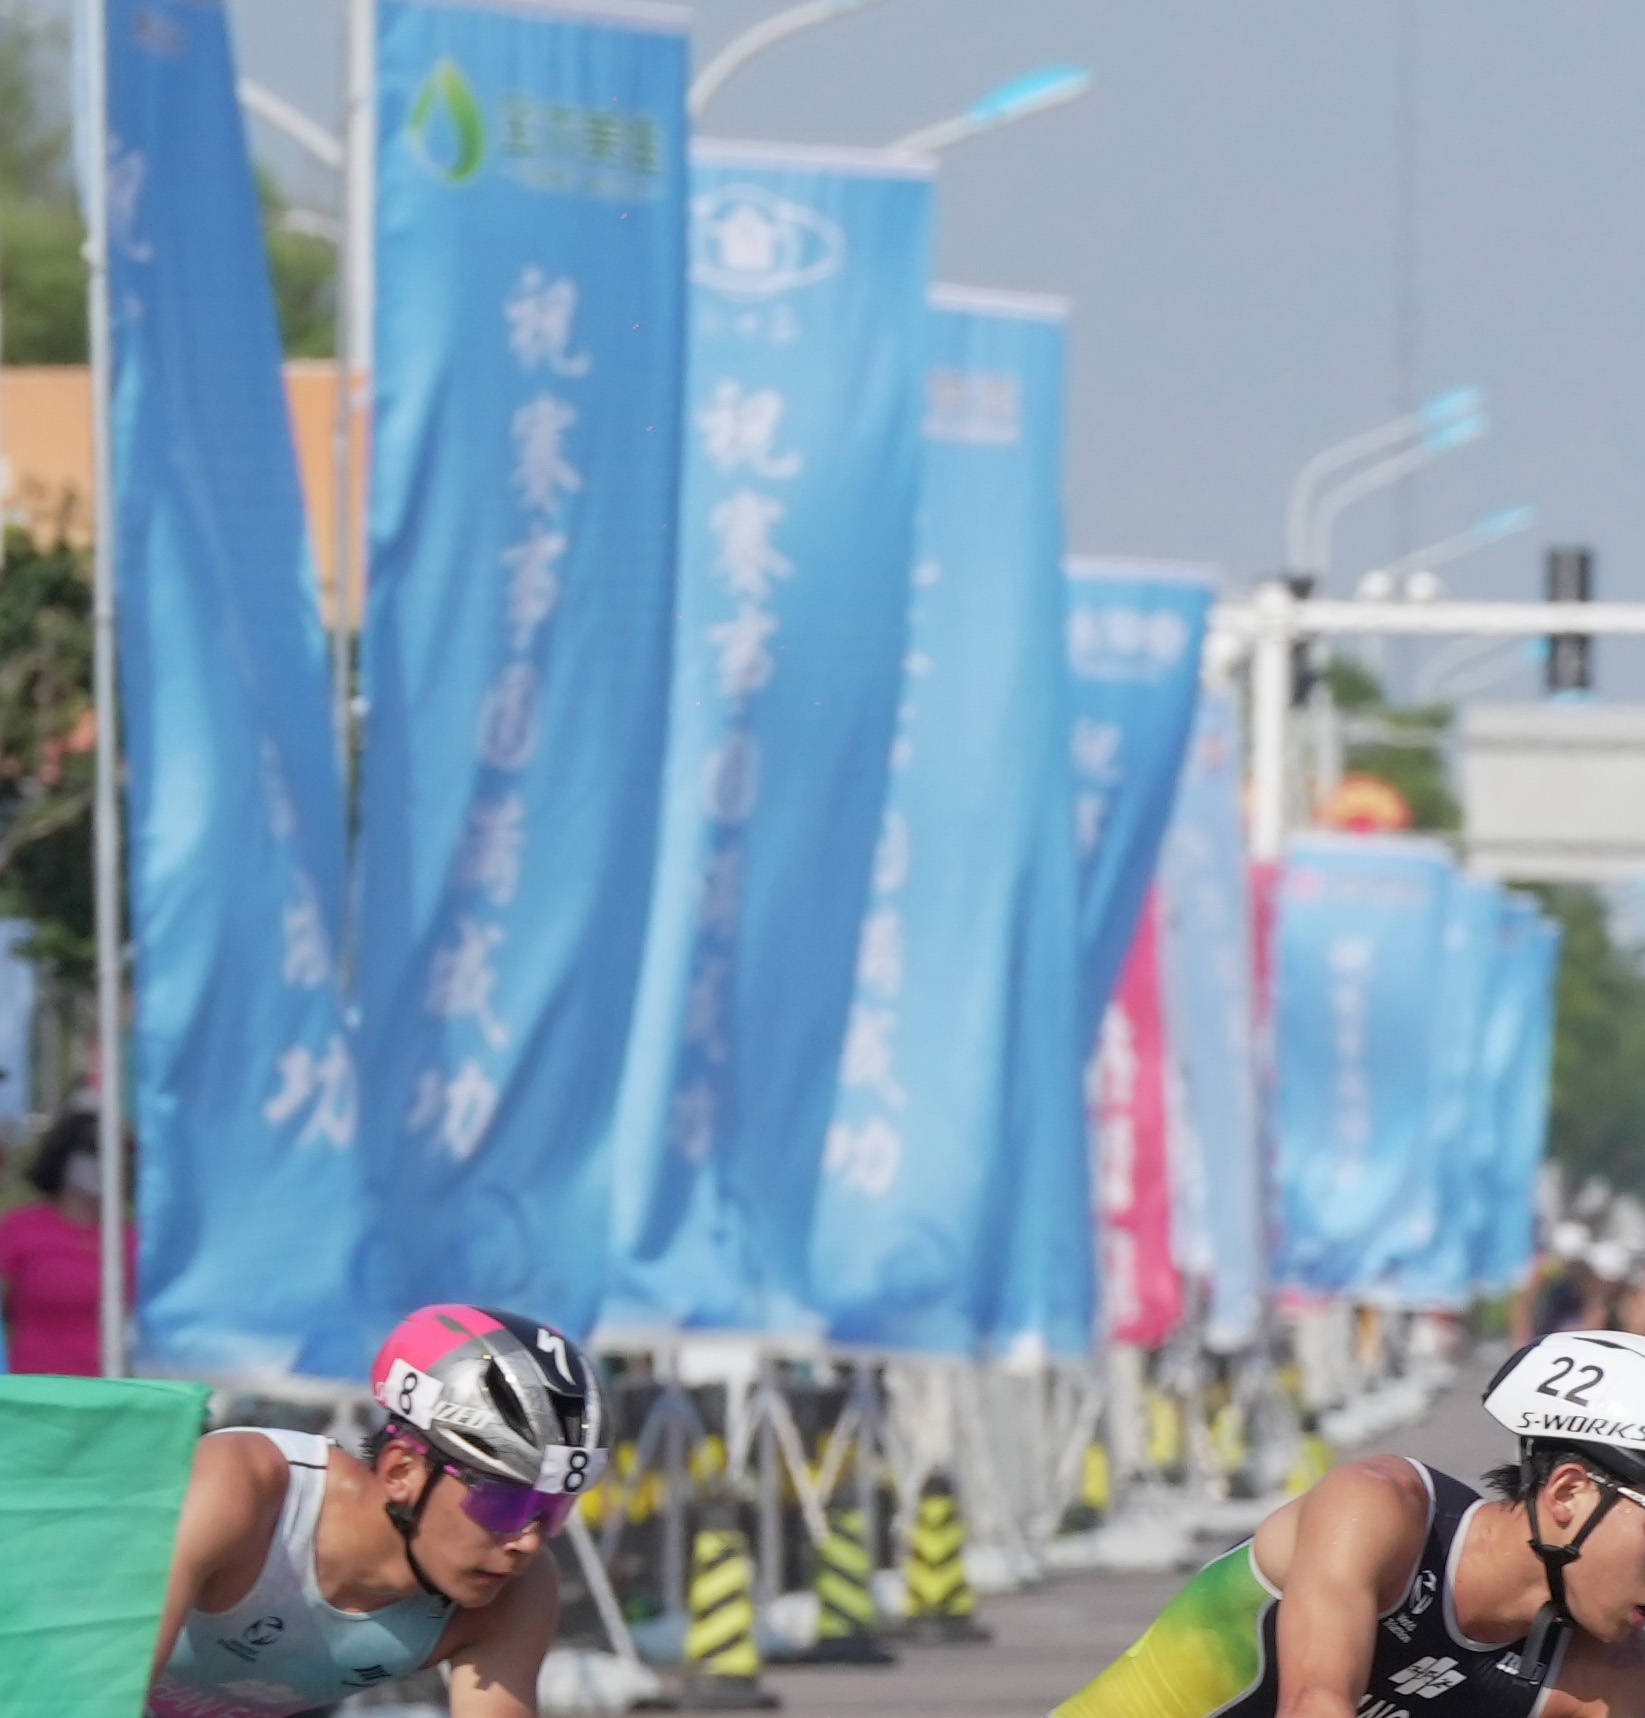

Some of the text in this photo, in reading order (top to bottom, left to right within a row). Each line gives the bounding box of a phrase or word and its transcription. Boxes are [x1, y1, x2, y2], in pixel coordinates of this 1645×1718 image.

[399, 1371, 418, 1415] 8
[1536, 1356, 1605, 1407] 22
[563, 1449, 589, 1493] 8
